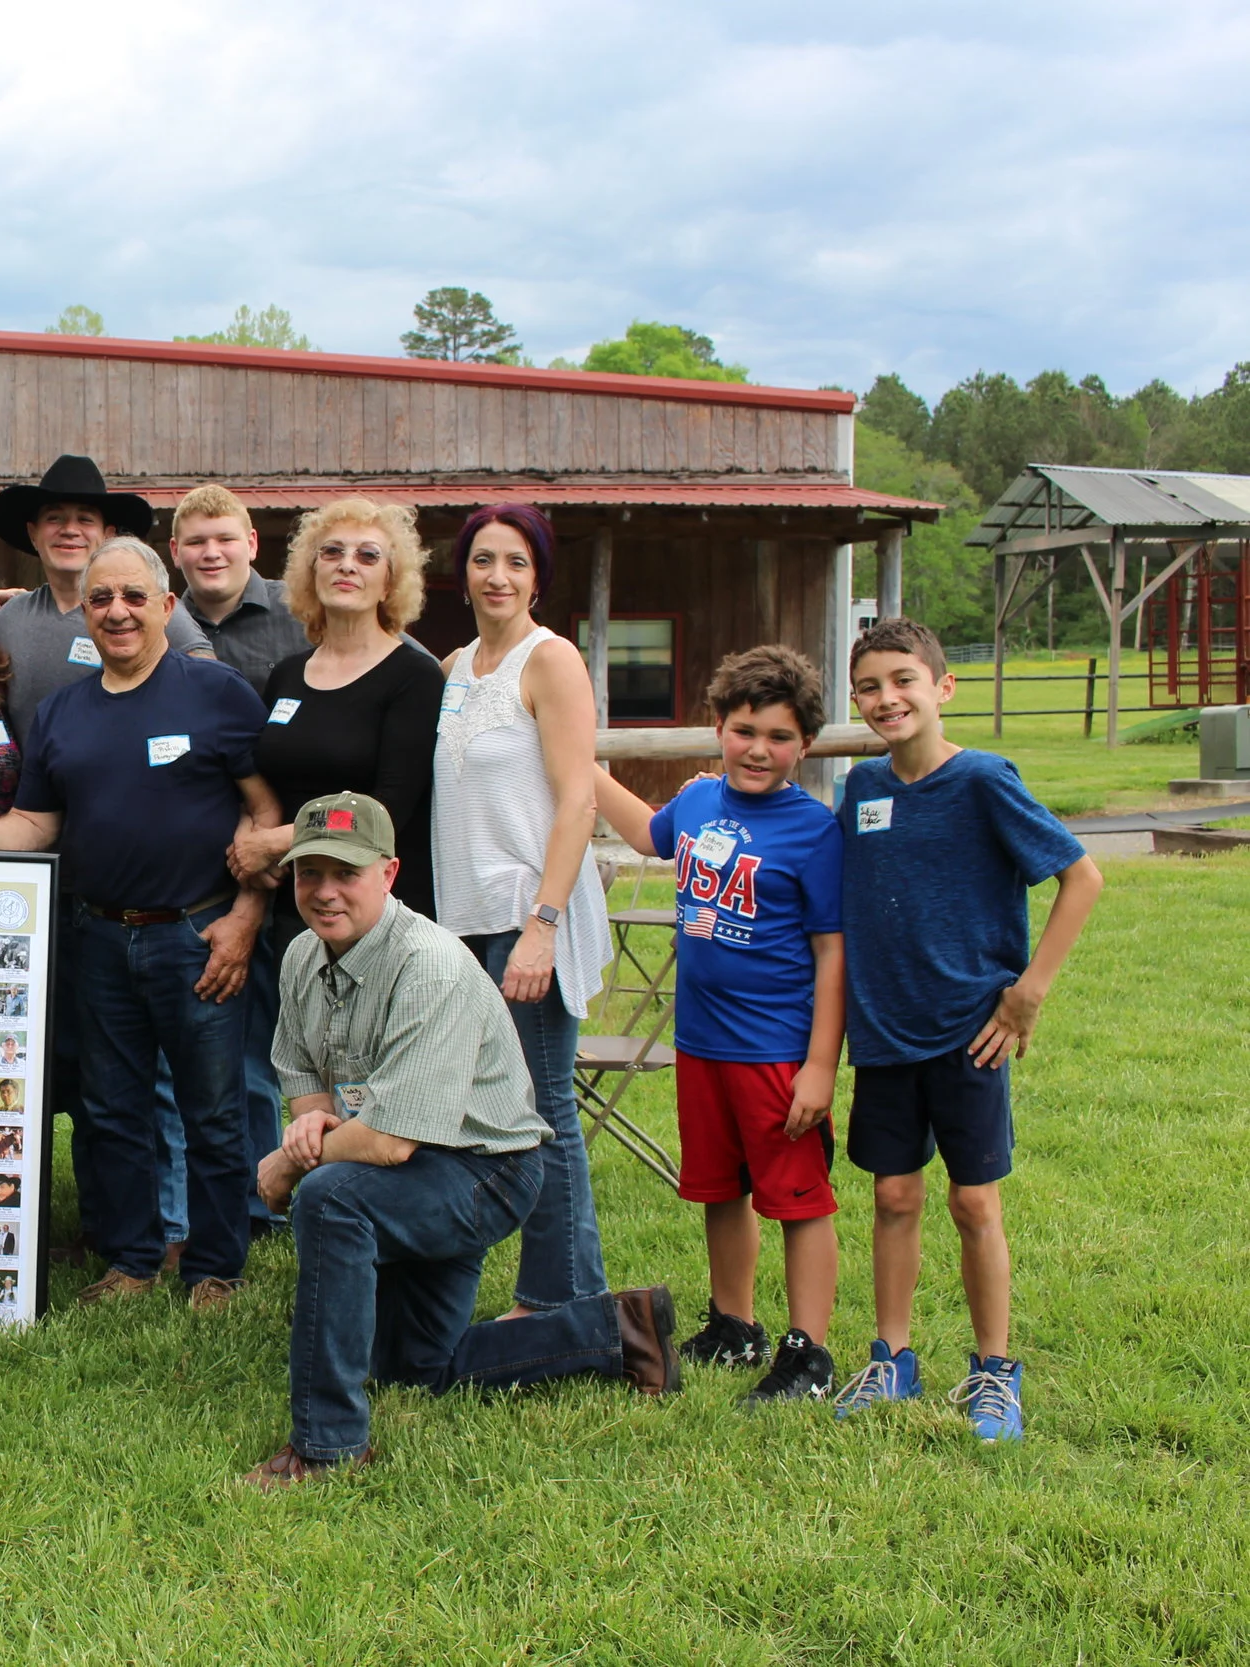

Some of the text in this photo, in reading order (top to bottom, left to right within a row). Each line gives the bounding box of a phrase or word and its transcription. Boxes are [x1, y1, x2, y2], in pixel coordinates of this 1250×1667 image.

[718, 819, 728, 827] OF
[729, 820, 740, 829] THE
[738, 826, 753, 845] BRAVE
[675, 831, 762, 919] USA
